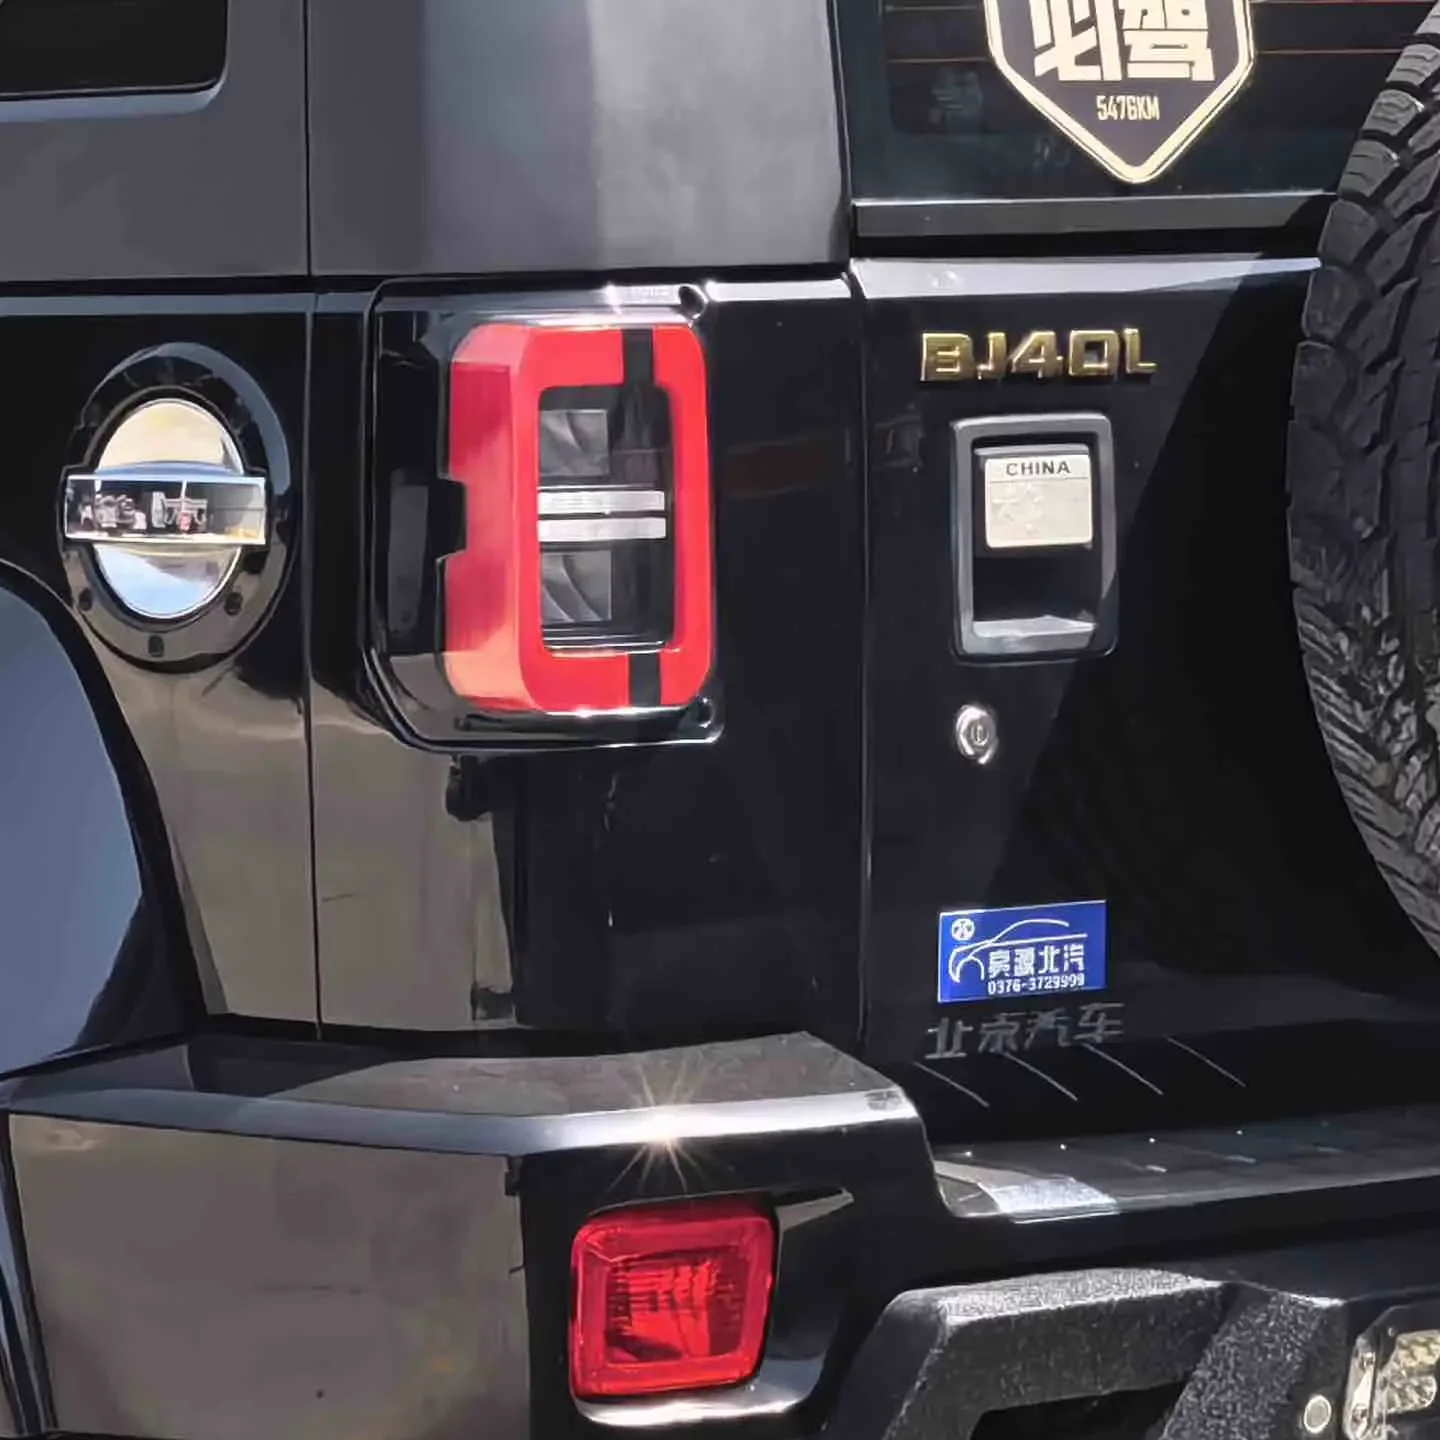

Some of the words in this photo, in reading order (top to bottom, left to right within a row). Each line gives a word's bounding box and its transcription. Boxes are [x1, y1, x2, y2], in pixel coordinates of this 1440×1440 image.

[1096, 95, 1160, 121] 5476KM
[921, 328, 1158, 382] BJ40L
[1005, 461, 1071, 477] CHINA
[924, 1003, 1125, 1060] 北京汽车
